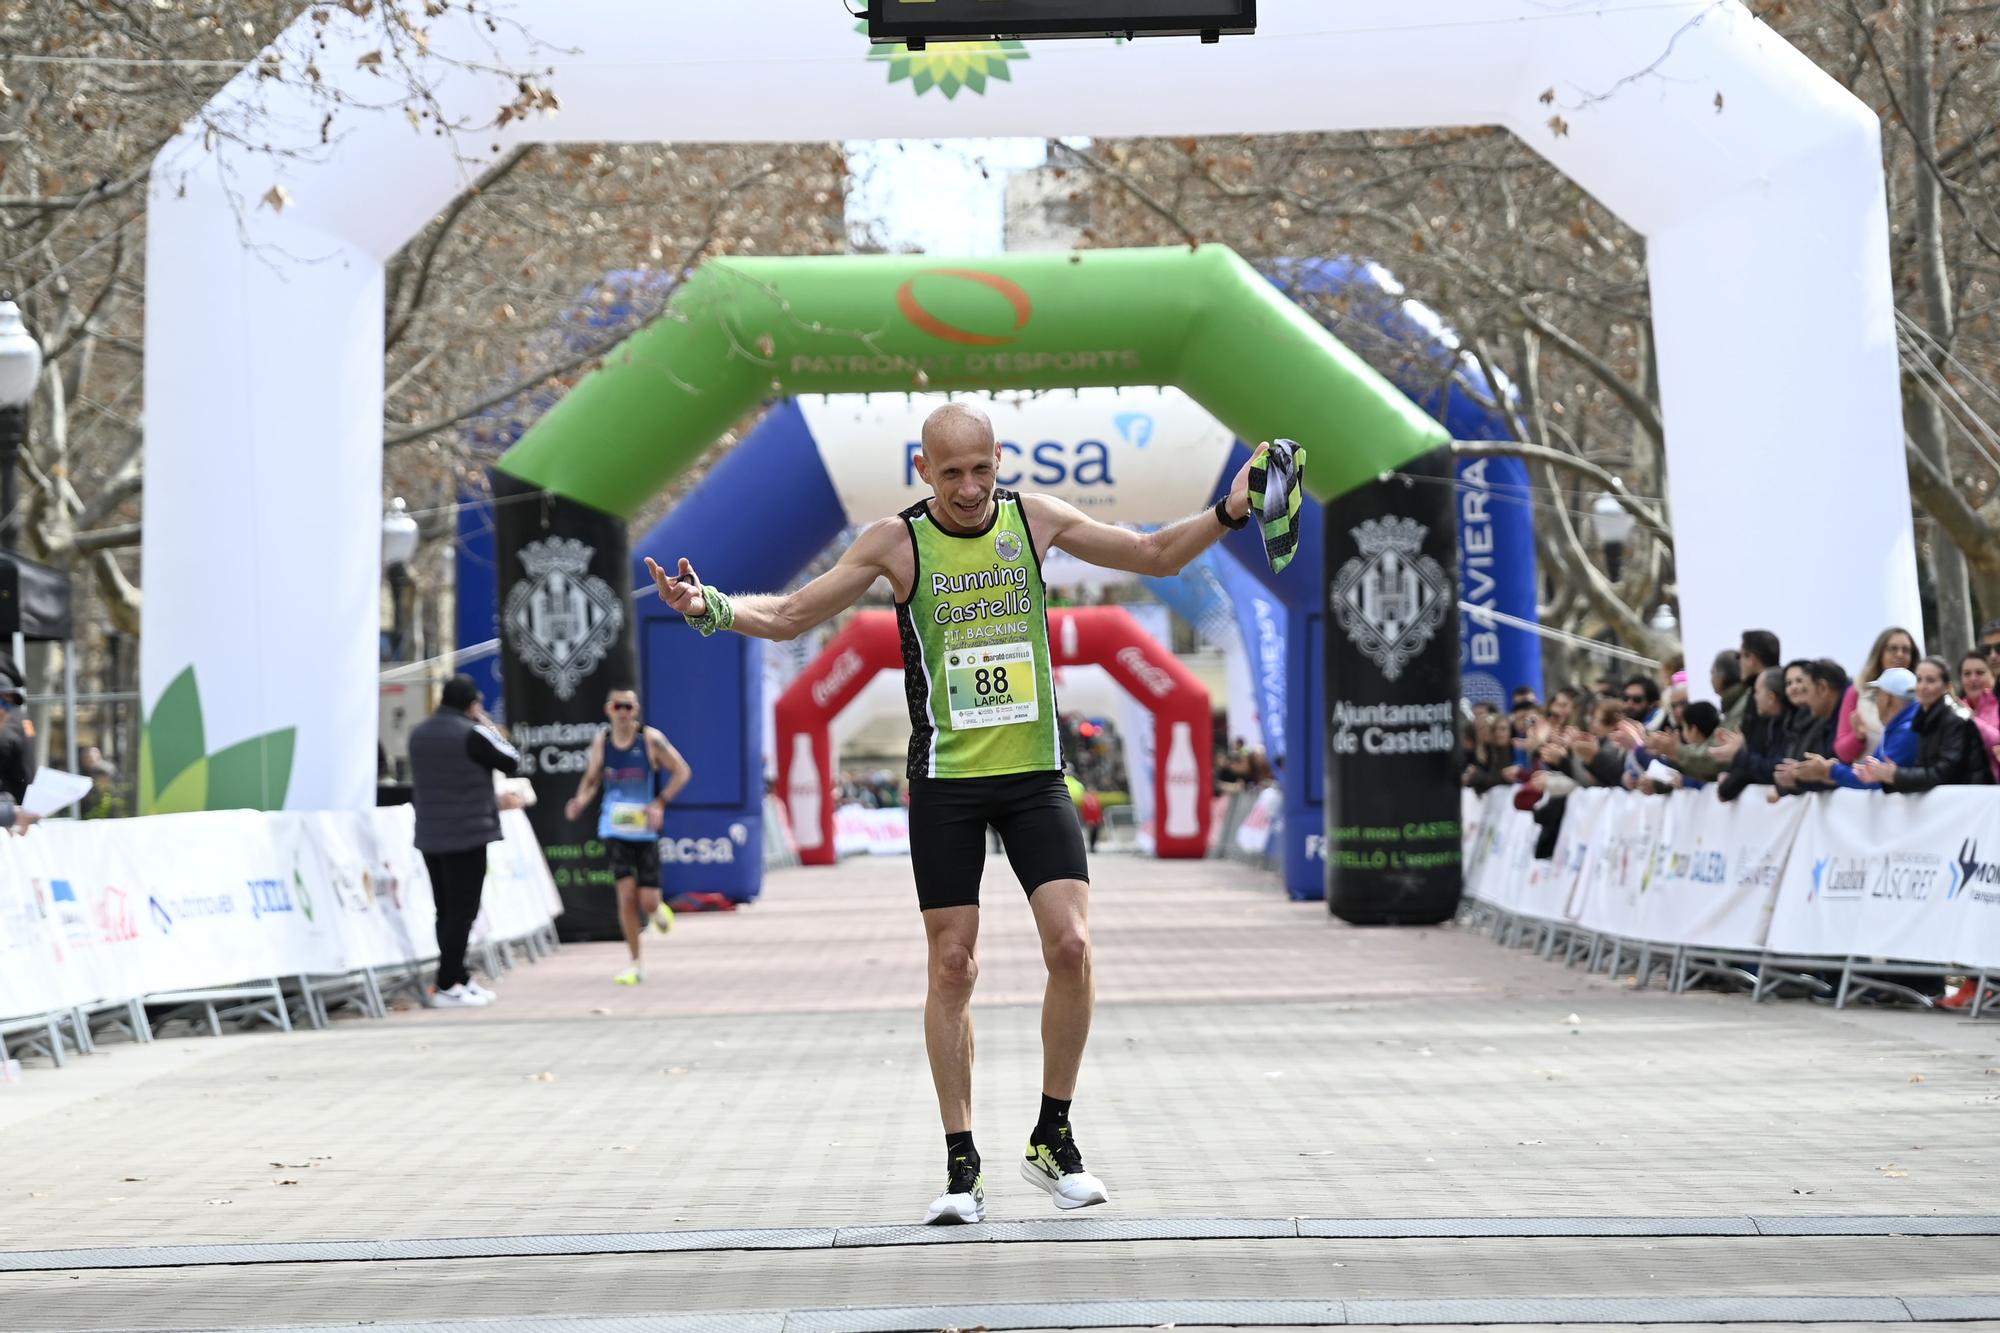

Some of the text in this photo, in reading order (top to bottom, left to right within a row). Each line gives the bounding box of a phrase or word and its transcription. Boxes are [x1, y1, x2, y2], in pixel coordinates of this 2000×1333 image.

[790, 350, 1142, 375] PATRONAT D'ESPORTS
[1462, 458, 1500, 665] BAVIERA
[931, 563, 1028, 597] Running
[934, 588, 1031, 625] Castelló
[975, 666, 1009, 695] 88
[974, 694, 1014, 707] LAPICA
[1332, 701, 1453, 730] Ajuntament
[1333, 724, 1455, 754] de Castelló
